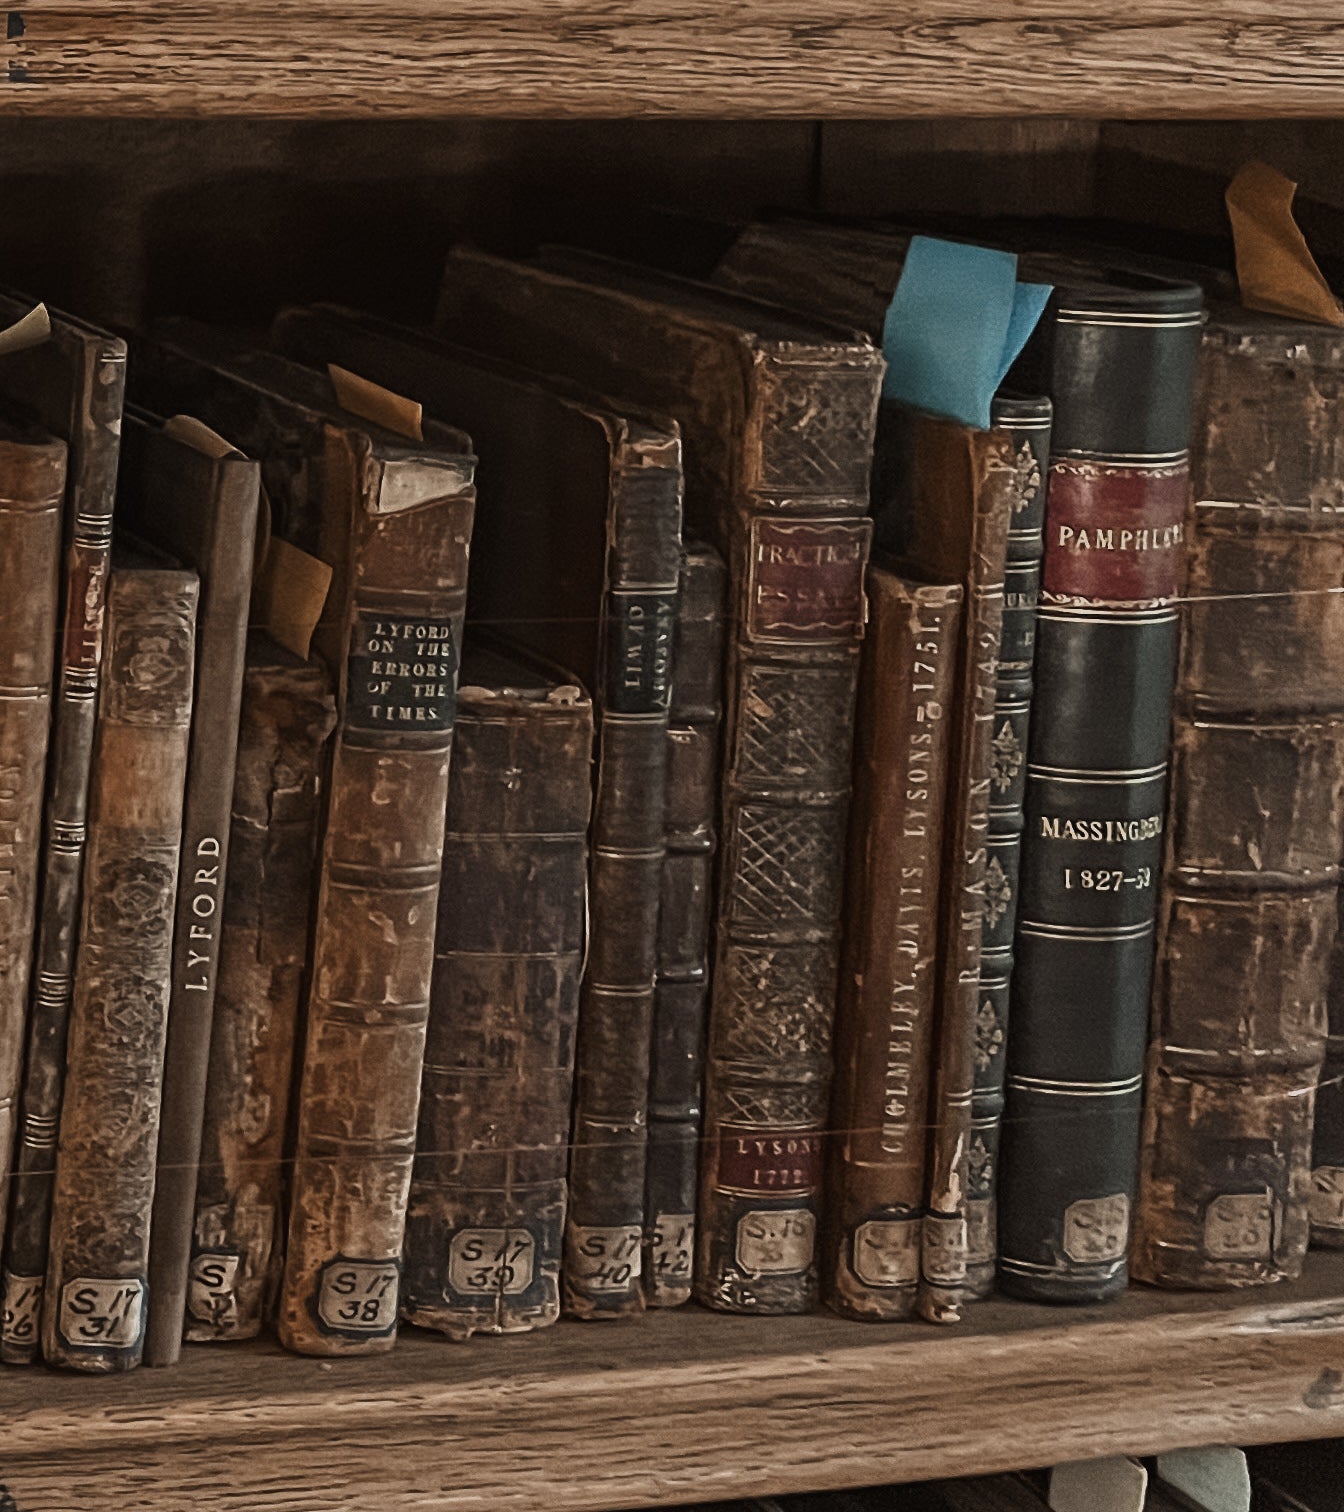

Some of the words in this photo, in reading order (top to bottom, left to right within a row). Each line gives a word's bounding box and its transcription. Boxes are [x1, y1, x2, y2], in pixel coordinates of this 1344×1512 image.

[374, 622, 451, 640] LYFORD
[367, 639, 395, 655] ON
[416, 642, 452, 658] THE
[371, 659, 449, 678] ERRORS
[367, 680, 392, 696] OF
[414, 682, 448, 698] THE
[369, 704, 439, 721] TIMES
[903, 723, 933, 837] LYSONS.
[961, 777, 992, 932] MASON
[184, 836, 221, 992] LYFORD
[895, 854, 927, 957] DAVIS.
[460, 1239, 485, 1261] S
[493, 1240, 532, 1263] 17
[580, 1236, 607, 1259] S
[199, 1264, 226, 1287] S
[593, 1262, 633, 1285] 40
[332, 1274, 359, 1297] S
[367, 1274, 397, 1299] 17
[67, 1289, 96, 1315] S
[109, 1288, 140, 1311] 17
[338, 1299, 381, 1323] 38
